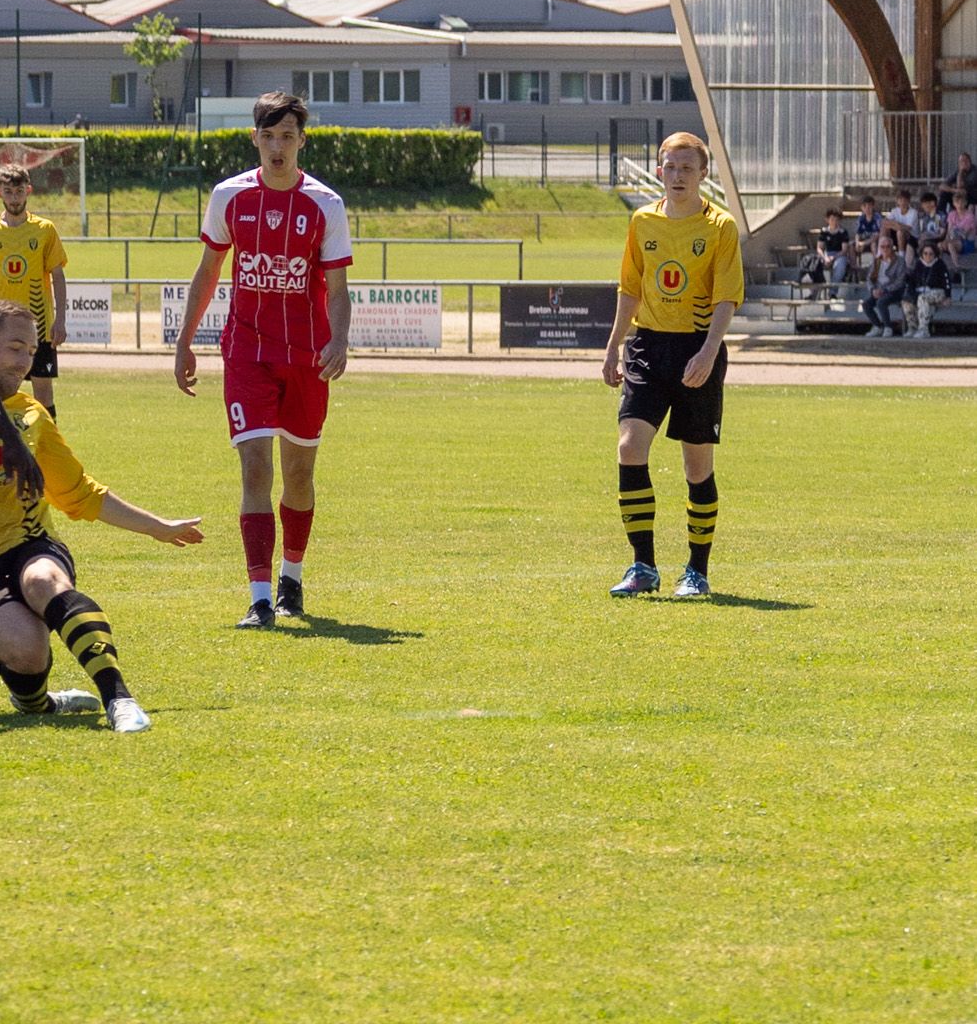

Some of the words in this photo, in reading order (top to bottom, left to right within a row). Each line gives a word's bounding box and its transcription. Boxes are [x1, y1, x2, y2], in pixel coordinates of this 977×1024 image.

[296, 214, 307, 235] 9
[8, 261, 22, 274] U
[238, 271, 306, 290] POUTEAU
[664, 270, 680, 288] U
[72, 296, 108, 311] DÉCORS
[349, 291, 364, 304] RL
[369, 289, 438, 304] BARROCHE
[528, 305, 552, 314] Breton
[558, 306, 589, 314] Jeanneau
[352, 318, 386, 326] ETTOYAGE
[230, 402, 246, 431] 9
